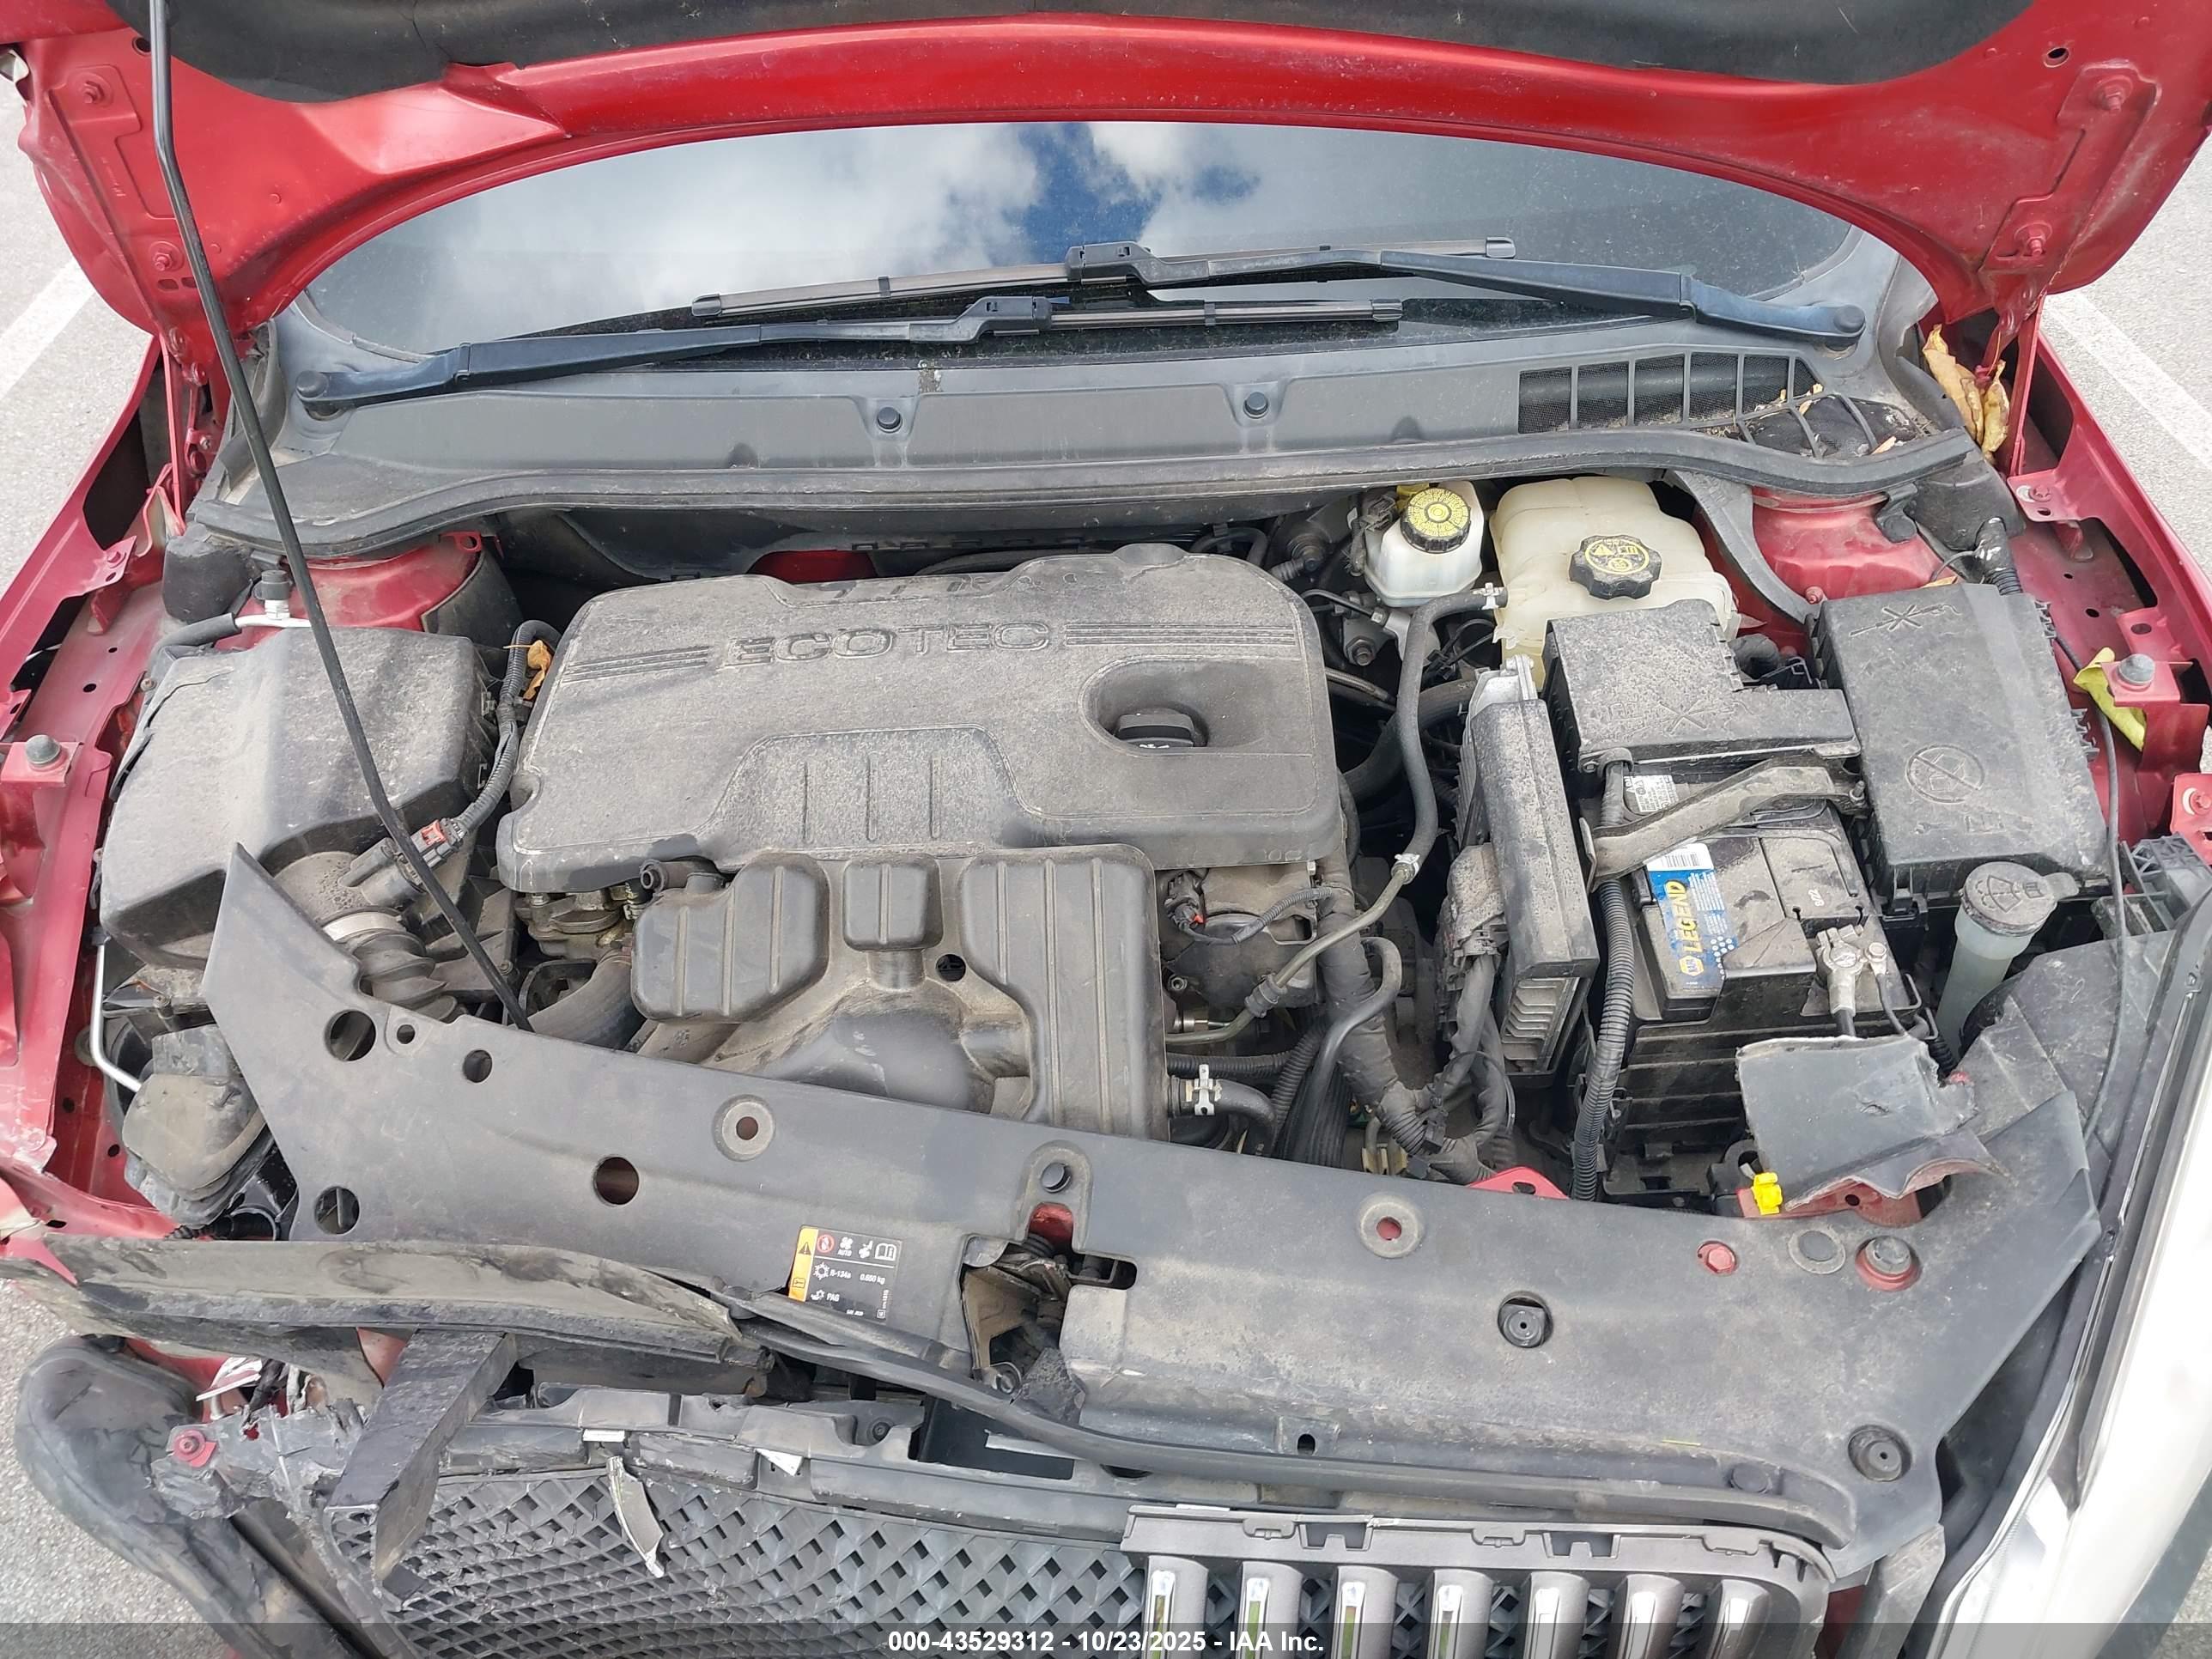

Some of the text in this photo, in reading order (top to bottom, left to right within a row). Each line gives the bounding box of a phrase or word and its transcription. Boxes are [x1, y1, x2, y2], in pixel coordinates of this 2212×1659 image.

[726, 622, 1049, 665] ECOTEC
[1663, 879, 1703, 953] LEGEND
[826, 1292, 840, 1302] PAG
